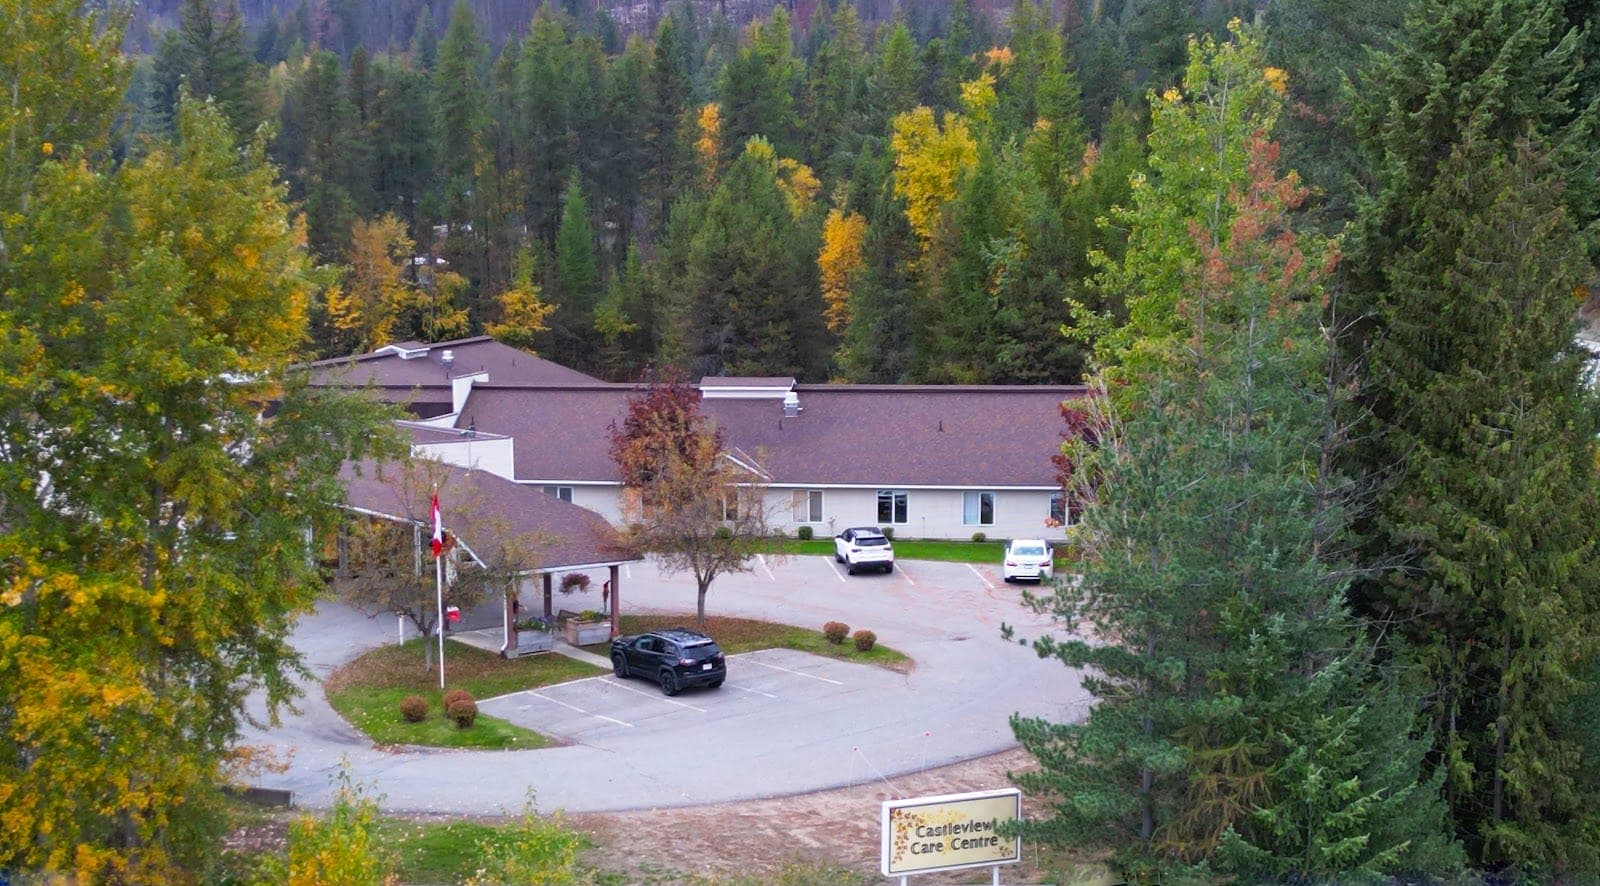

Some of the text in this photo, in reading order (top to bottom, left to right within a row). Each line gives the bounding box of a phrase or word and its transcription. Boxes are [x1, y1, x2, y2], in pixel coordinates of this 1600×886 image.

[916, 820, 992, 838] Castleview
[911, 836, 998, 855] Care Centre
